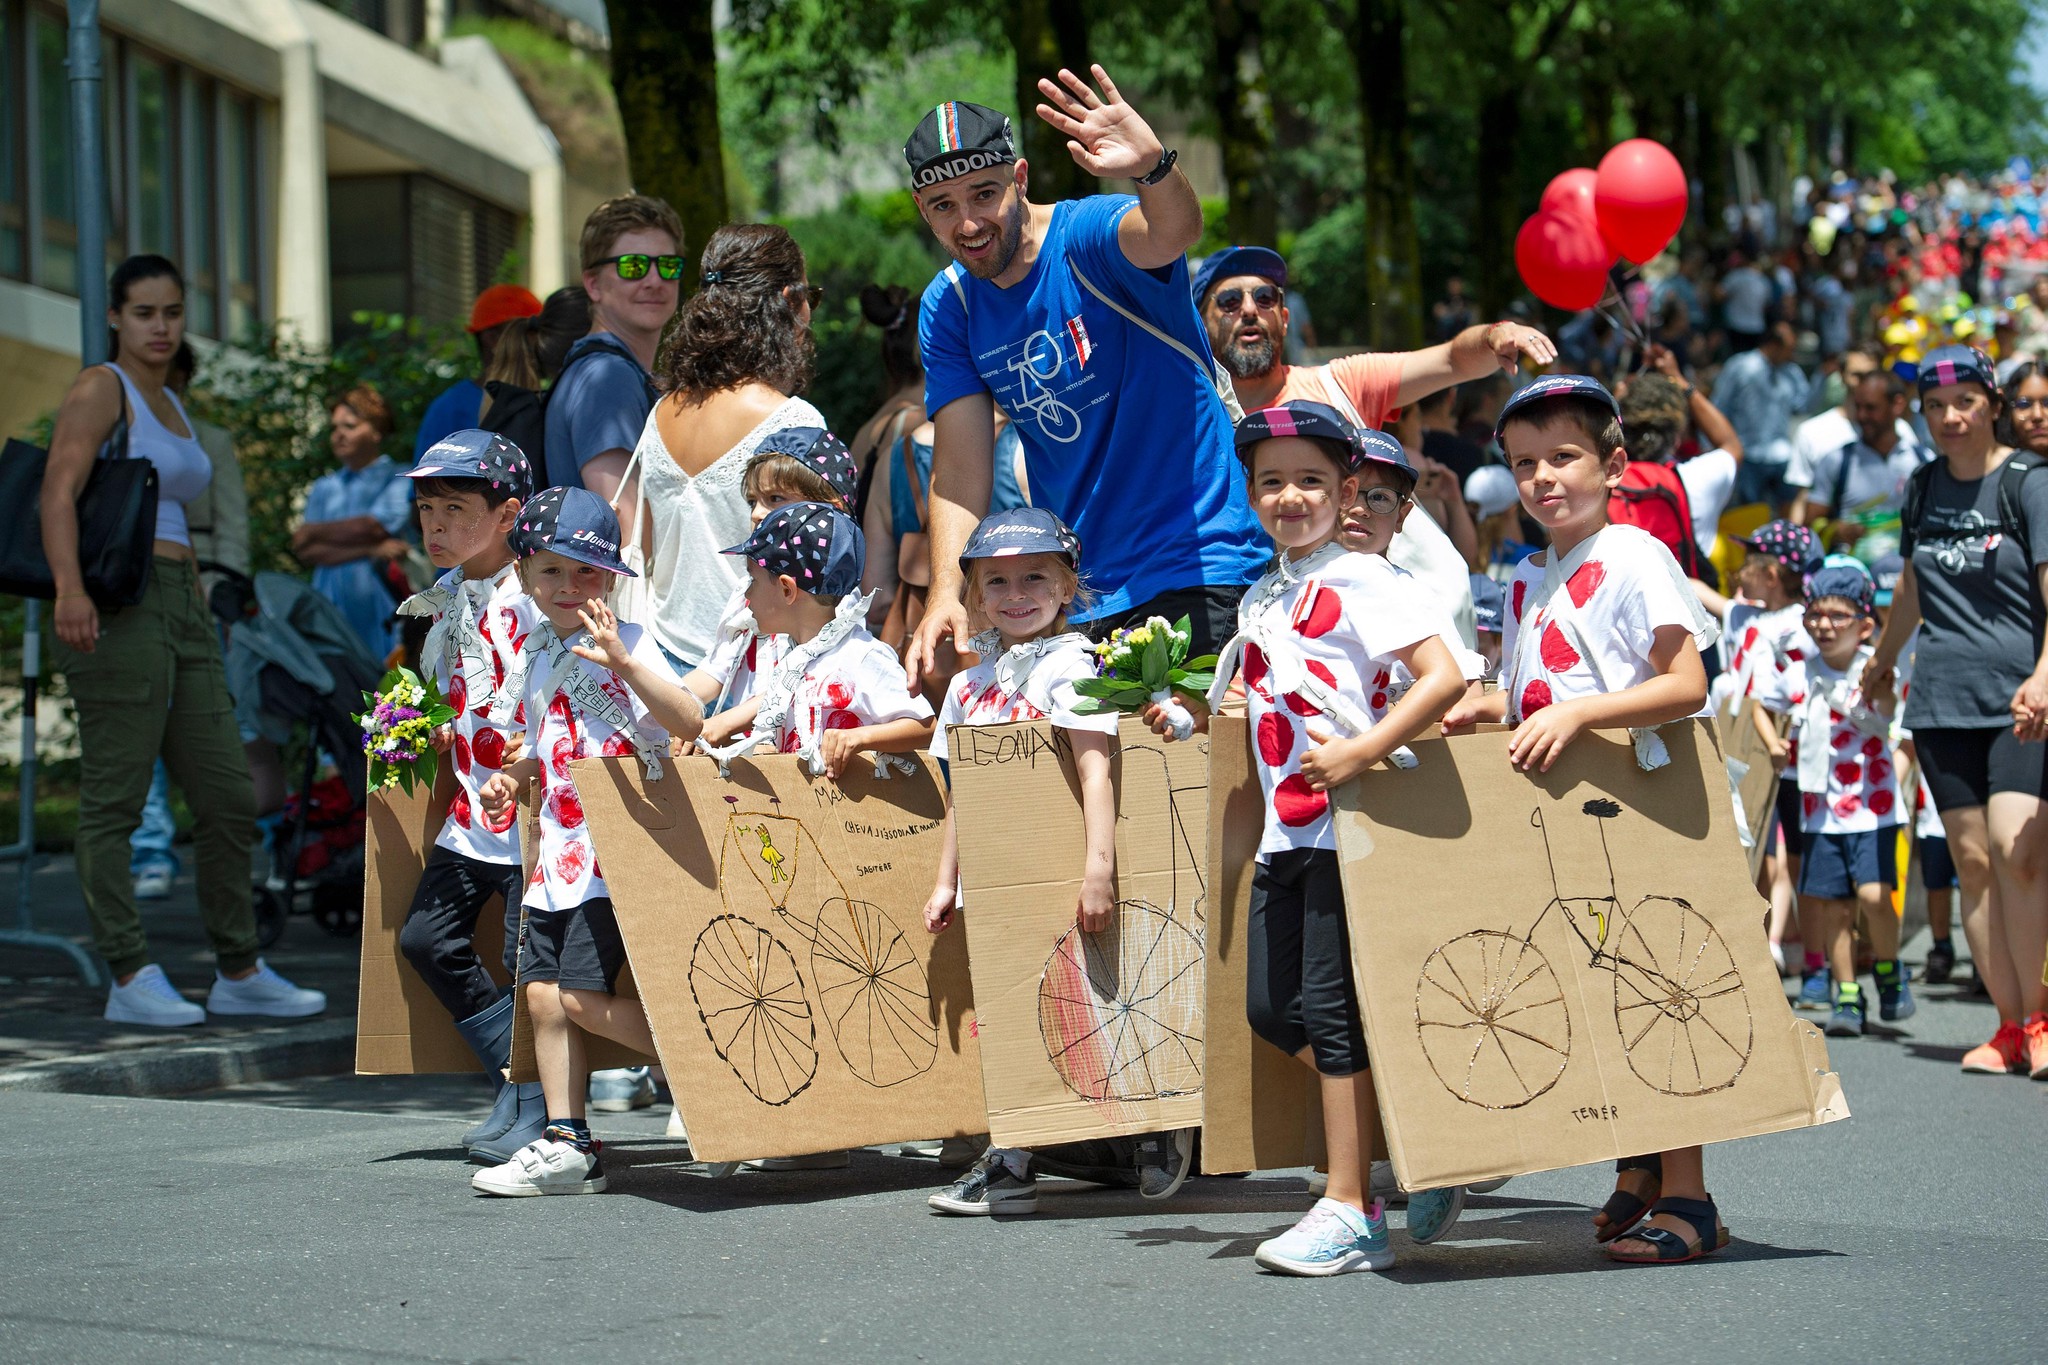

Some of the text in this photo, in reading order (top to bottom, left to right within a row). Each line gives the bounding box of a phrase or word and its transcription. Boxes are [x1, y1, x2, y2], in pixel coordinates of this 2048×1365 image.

[912, 151, 1003, 189] LONDON
[1246, 418, 1318, 429] #LOVETHEPAIN
[984, 524, 1046, 539] JORDAN
[815, 786, 846, 808] MAX
